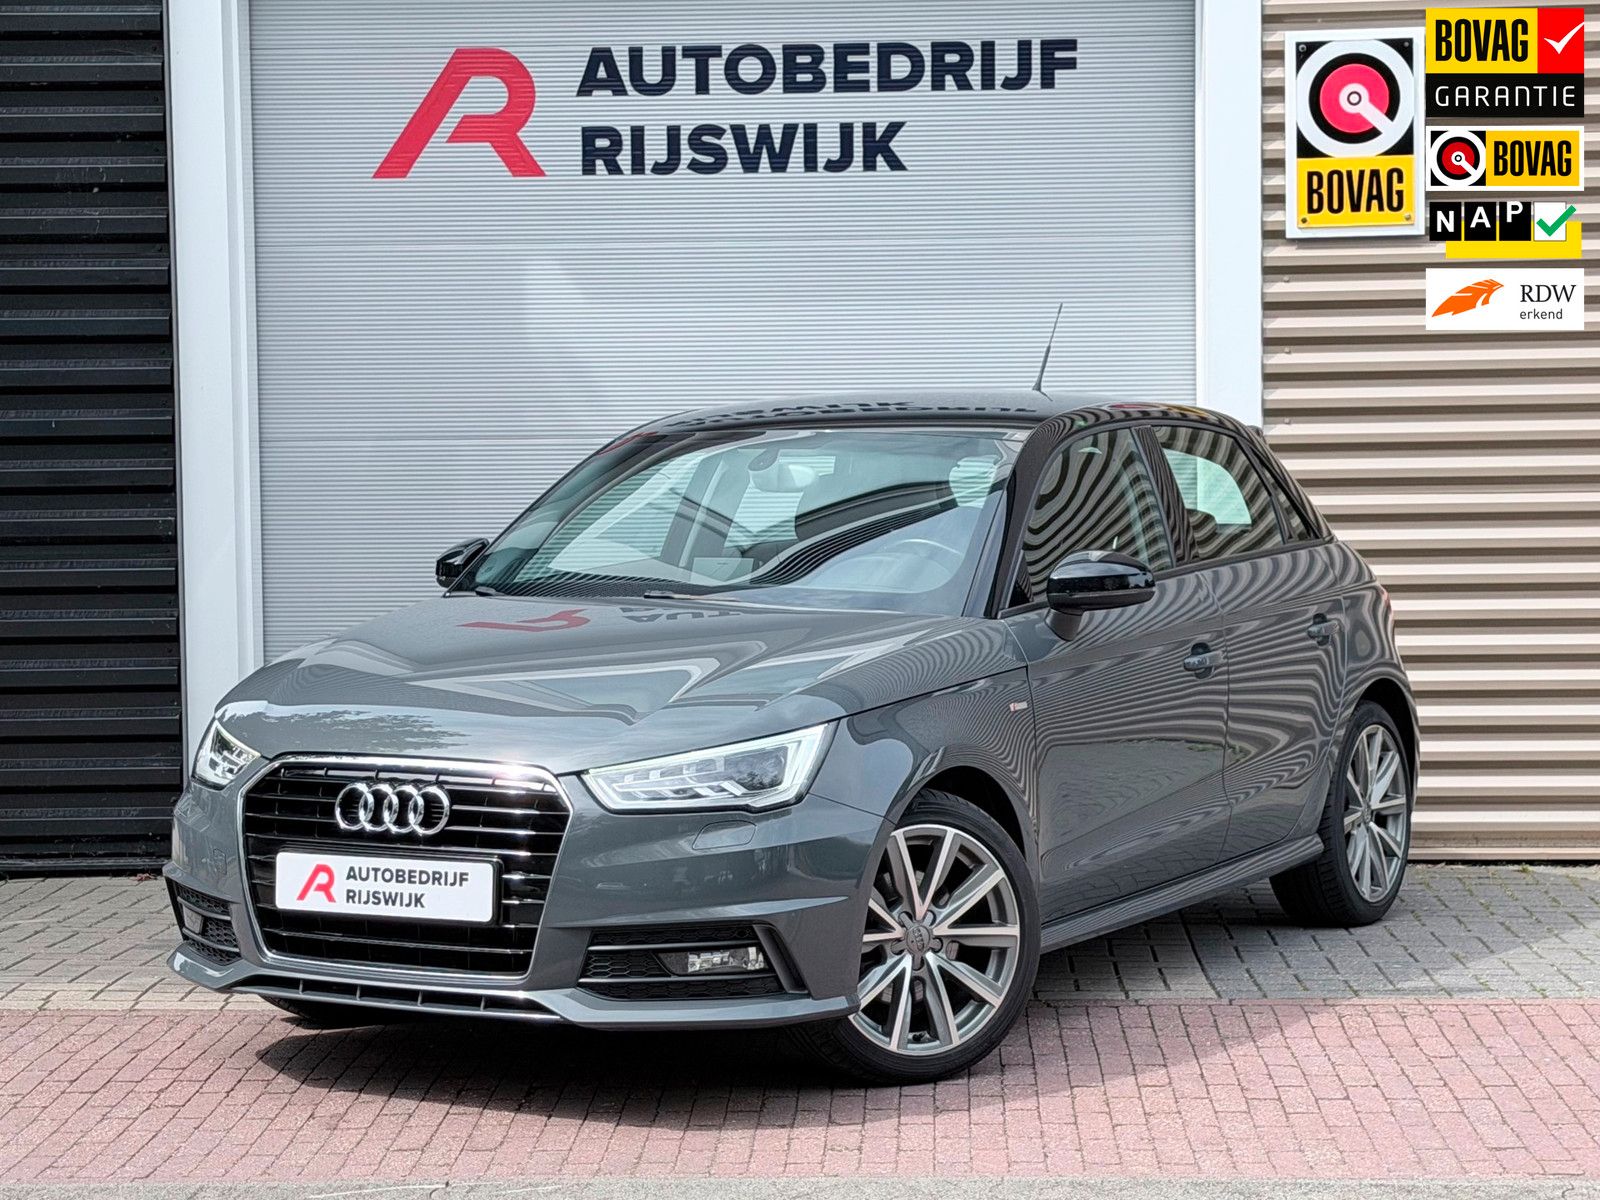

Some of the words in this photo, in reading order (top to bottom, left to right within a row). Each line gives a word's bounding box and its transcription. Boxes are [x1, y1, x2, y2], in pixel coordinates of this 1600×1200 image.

[576, 39, 1078, 98] AUTOBEDRIJF
[581, 121, 908, 176] RIJSWIJK
[1307, 167, 1405, 215] BOVAG
[345, 865, 470, 887] AUTOBEDRIJF
[345, 888, 426, 909] RIJSWIJK
